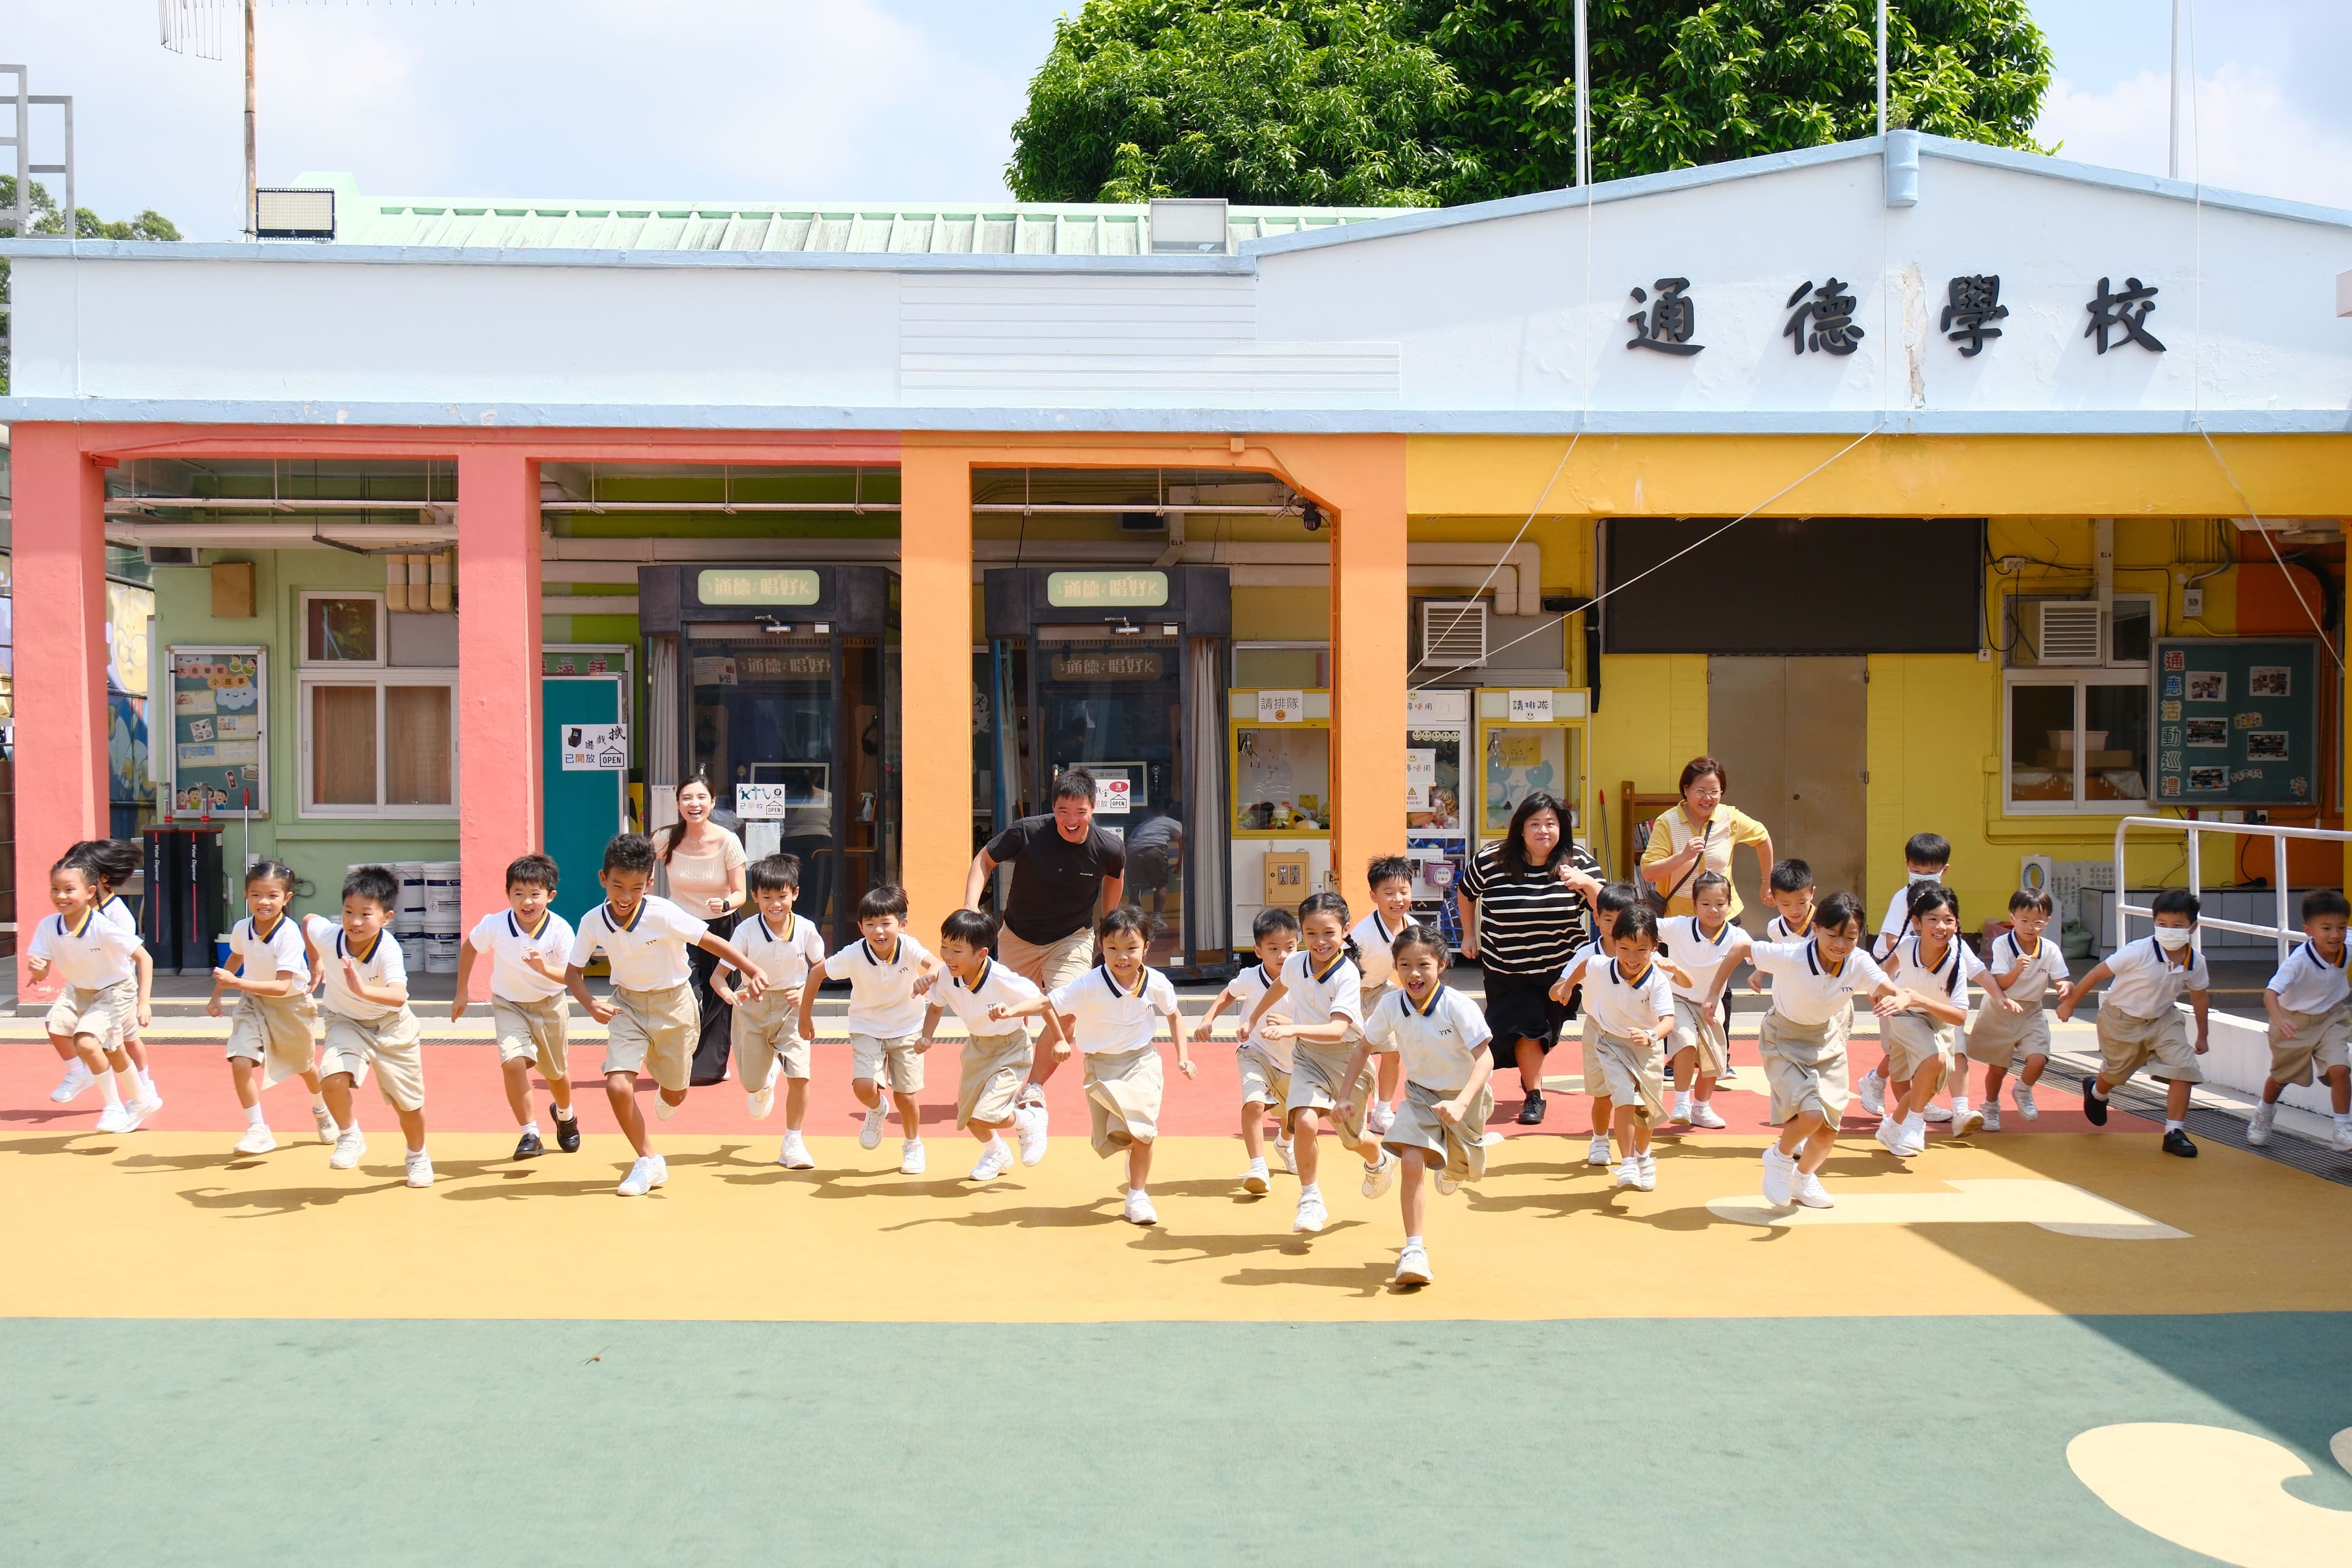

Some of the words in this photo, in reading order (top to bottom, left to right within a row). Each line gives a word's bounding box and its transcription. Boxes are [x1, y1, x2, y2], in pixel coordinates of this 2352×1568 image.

[1626, 274, 2167, 358] 通德學校
[1261, 696, 1299, 710] 請排隊
[1512, 700, 1548, 710] 請排隊
[2161, 650, 2184, 796] 通德活動巡禮
[565, 753, 595, 764] 已開放
